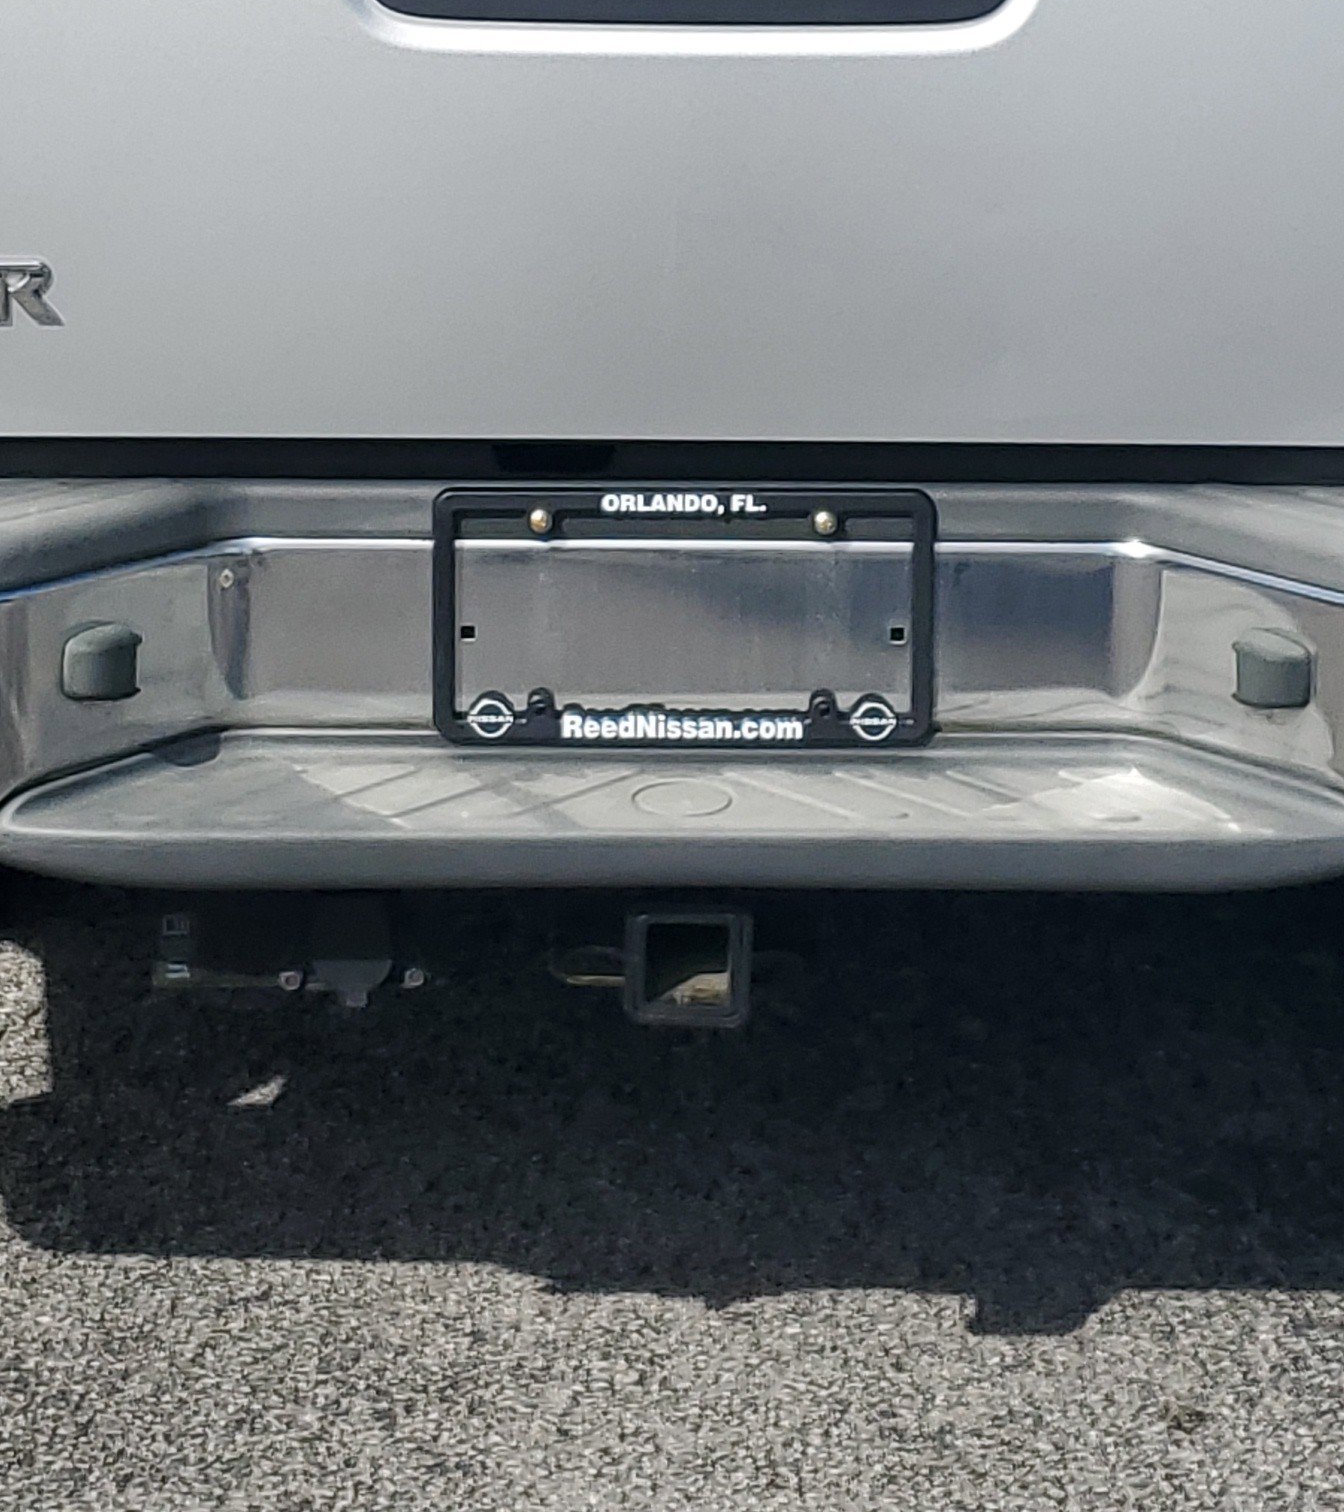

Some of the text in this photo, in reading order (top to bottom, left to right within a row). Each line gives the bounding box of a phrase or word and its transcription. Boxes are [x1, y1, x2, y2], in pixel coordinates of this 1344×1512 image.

[600, 494, 767, 516] ORLANDO, FL.
[561, 711, 804, 739] ReedNissan.com
